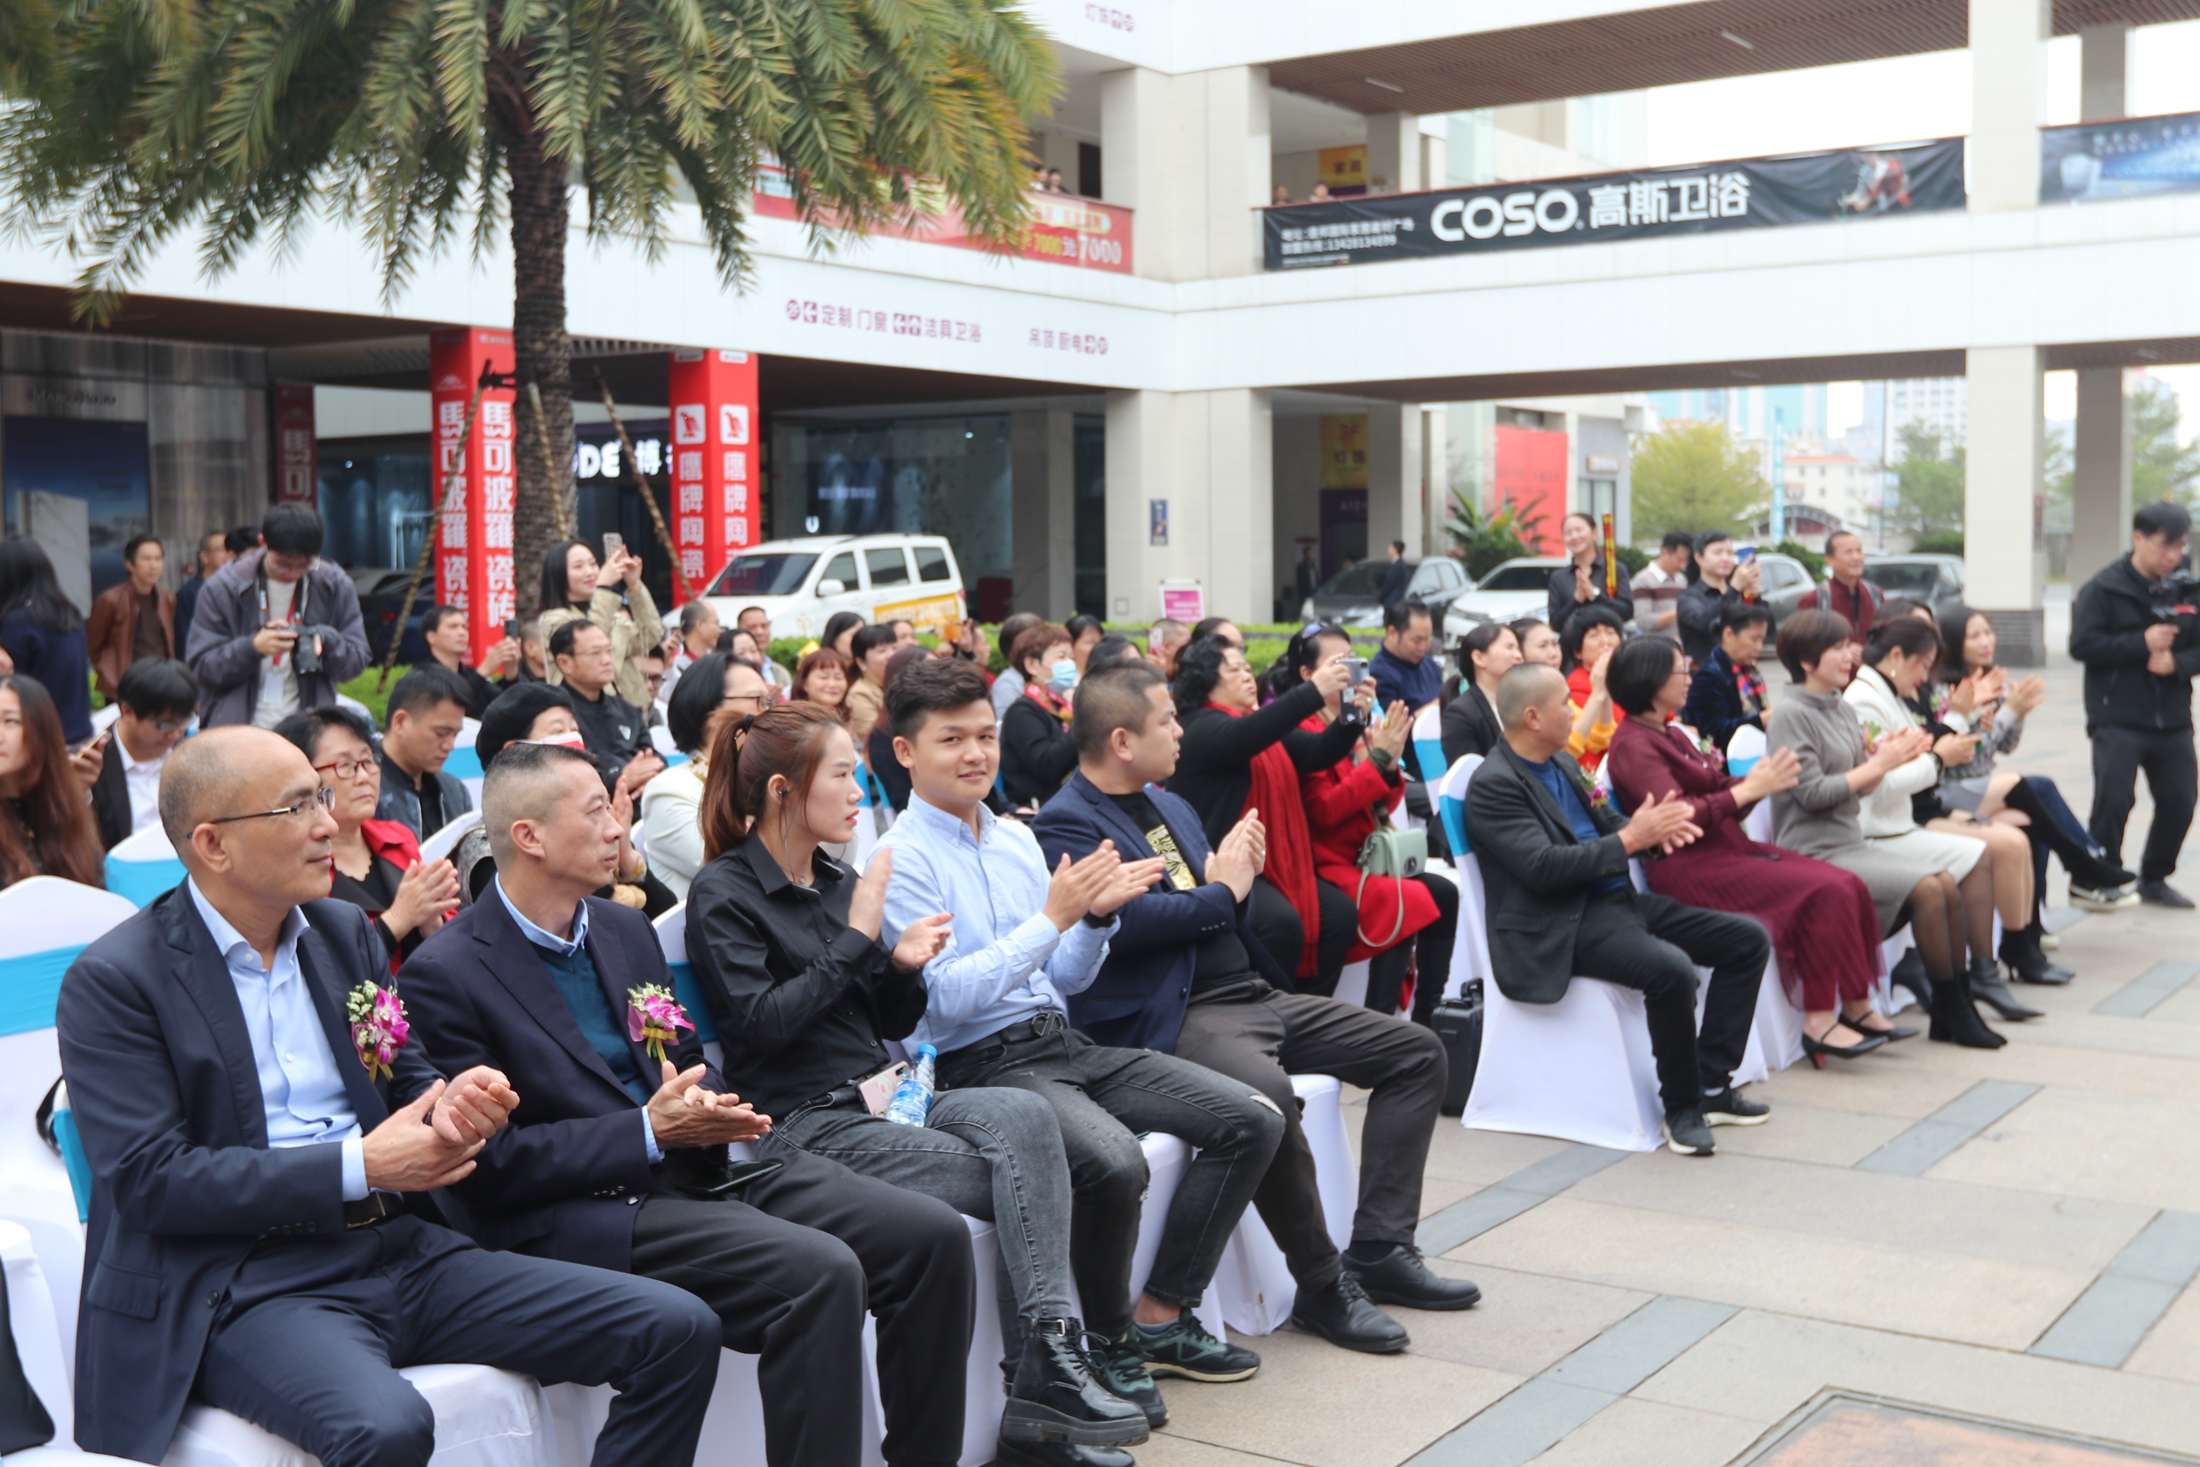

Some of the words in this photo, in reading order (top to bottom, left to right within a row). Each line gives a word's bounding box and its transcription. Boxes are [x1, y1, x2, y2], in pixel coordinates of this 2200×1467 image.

[1430, 187, 1579, 242] COSO
[1589, 172, 1750, 229] 高斯卫浴
[822, 305, 852, 328] 定制
[858, 309, 887, 332] 门窗
[925, 318, 981, 343] 洁具卫浴
[573, 441, 621, 478] DE
[634, 438, 673, 475] 博
